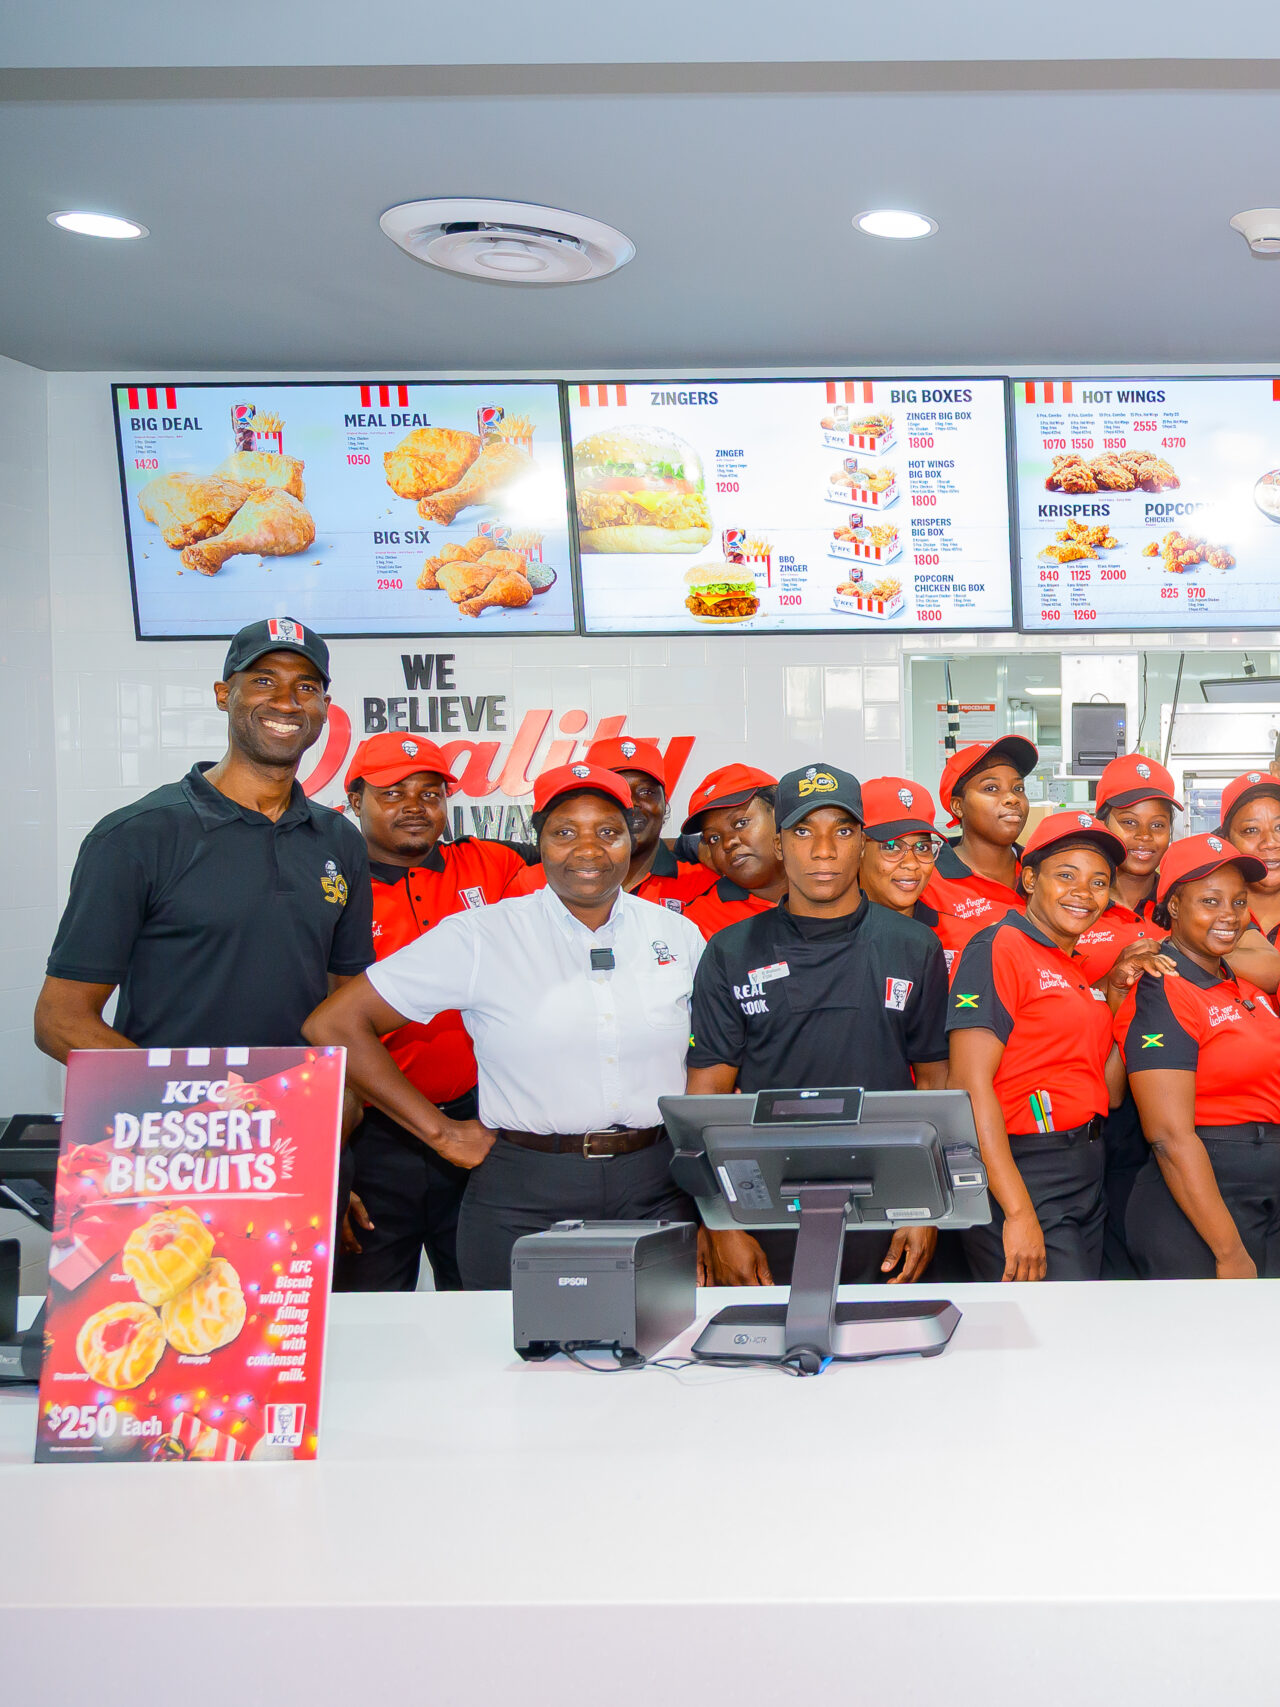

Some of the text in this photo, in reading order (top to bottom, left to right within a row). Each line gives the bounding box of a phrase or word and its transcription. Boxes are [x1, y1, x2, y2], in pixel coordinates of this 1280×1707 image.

[651, 392, 718, 405] ZINGERS
[891, 389, 972, 403] BIG BOXES
[1082, 390, 1165, 403] HOT WINGS
[131, 418, 203, 431] BIG DEAL
[345, 414, 431, 427] MEAL DEAL
[1134, 421, 1157, 431] 2555
[909, 437, 934, 448] 1800
[1043, 439, 1066, 449] 1070
[1071, 439, 1094, 449] 1550
[1103, 438, 1126, 448] 1850
[1161, 437, 1186, 448] 4370
[135, 459, 158, 469] 1420
[347, 455, 370, 465] 1050
[928, 460, 954, 468] WINGS
[716, 482, 739, 492] 1200
[912, 495, 936, 506] 1800
[1039, 504, 1110, 517] KRISPERS
[374, 531, 430, 544] BIG SIX
[914, 555, 939, 565] 1800
[1040, 571, 1059, 581] 840
[1071, 570, 1091, 580] 1125
[1101, 570, 1126, 580] 2000
[377, 579, 403, 589] 2940
[915, 584, 950, 592] CHICKEN
[1161, 588, 1178, 598] 825
[1187, 588, 1205, 598] 970
[779, 595, 802, 605] 1200
[917, 610, 942, 621] 1800
[1041, 610, 1060, 620] 960
[1074, 610, 1096, 620] 1260
[401, 654, 456, 690] WE
[364, 695, 507, 734] BELIEVE
[966, 898, 986, 908] finger
[1087, 930, 1111, 939] finger
[734, 984, 766, 999] REAL
[741, 1000, 770, 1015] COOK
[162, 1081, 229, 1104] KFC
[113, 1110, 276, 1150] DESSERT
[110, 1153, 277, 1193] BISCUITS
[290, 1261, 312, 1273] KFC
[275, 1276, 314, 1288] Biscuit
[559, 1278, 587, 1286] EPSON
[259, 1291, 310, 1306] with fruit
[275, 1306, 309, 1322] filling
[269, 1322, 308, 1337] topped
[282, 1337, 306, 1350] with
[246, 1352, 306, 1366] condensed
[278, 1368, 306, 1381] milk.
[48, 1404, 162, 1439] $250 Each
[272, 1435, 296, 1444] KFC
